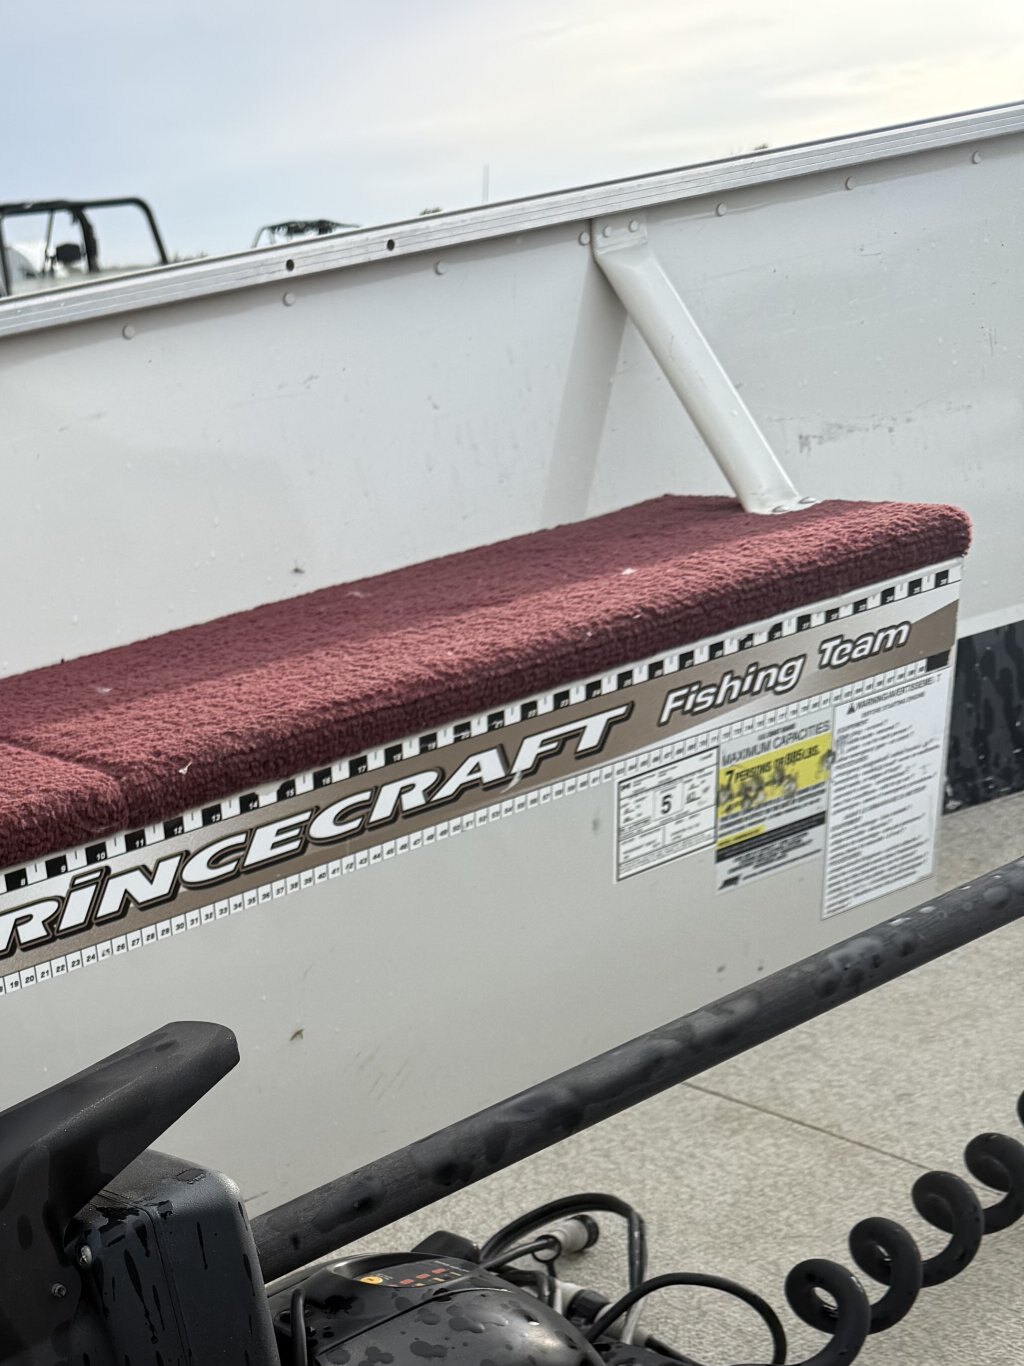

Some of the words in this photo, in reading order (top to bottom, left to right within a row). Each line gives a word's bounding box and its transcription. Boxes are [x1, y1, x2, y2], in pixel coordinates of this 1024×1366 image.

[657, 654, 806, 726] Fishing
[819, 621, 911, 669] Team
[721, 740, 772, 767] MAXIMUM
[773, 720, 831, 749] CAPACITIES
[20, 878, 26, 886] 8
[61, 865, 66, 873] 9
[96, 852, 106, 860] 10
[135, 839, 144, 847] 11
[174, 826, 183, 834] 12
[212, 813, 221, 822] 13
[249, 801, 258, 809] 14
[286, 788, 294, 797] 15
[660, 794, 674, 814] 5
[10, 980, 19, 989] 19
[25, 975, 35, 984] 20
[40, 969, 49, 978] 21
[56, 964, 65, 973] 22
[71, 959, 81, 968] 23
[86, 954, 96, 963] 24
[116, 943, 125, 952] 26
[131, 938, 140, 947] 27
[146, 933, 155, 941] 28
[161, 927, 170, 936] 29
[176, 922, 185, 931] 30
[190, 917, 199, 926] 31
[205, 912, 213, 921] 32
[219, 907, 228, 915] 33
[233, 902, 242, 910] 34
[248, 896, 256, 905] 35
[262, 892, 270, 900] 36
[276, 886, 285, 895] 37
